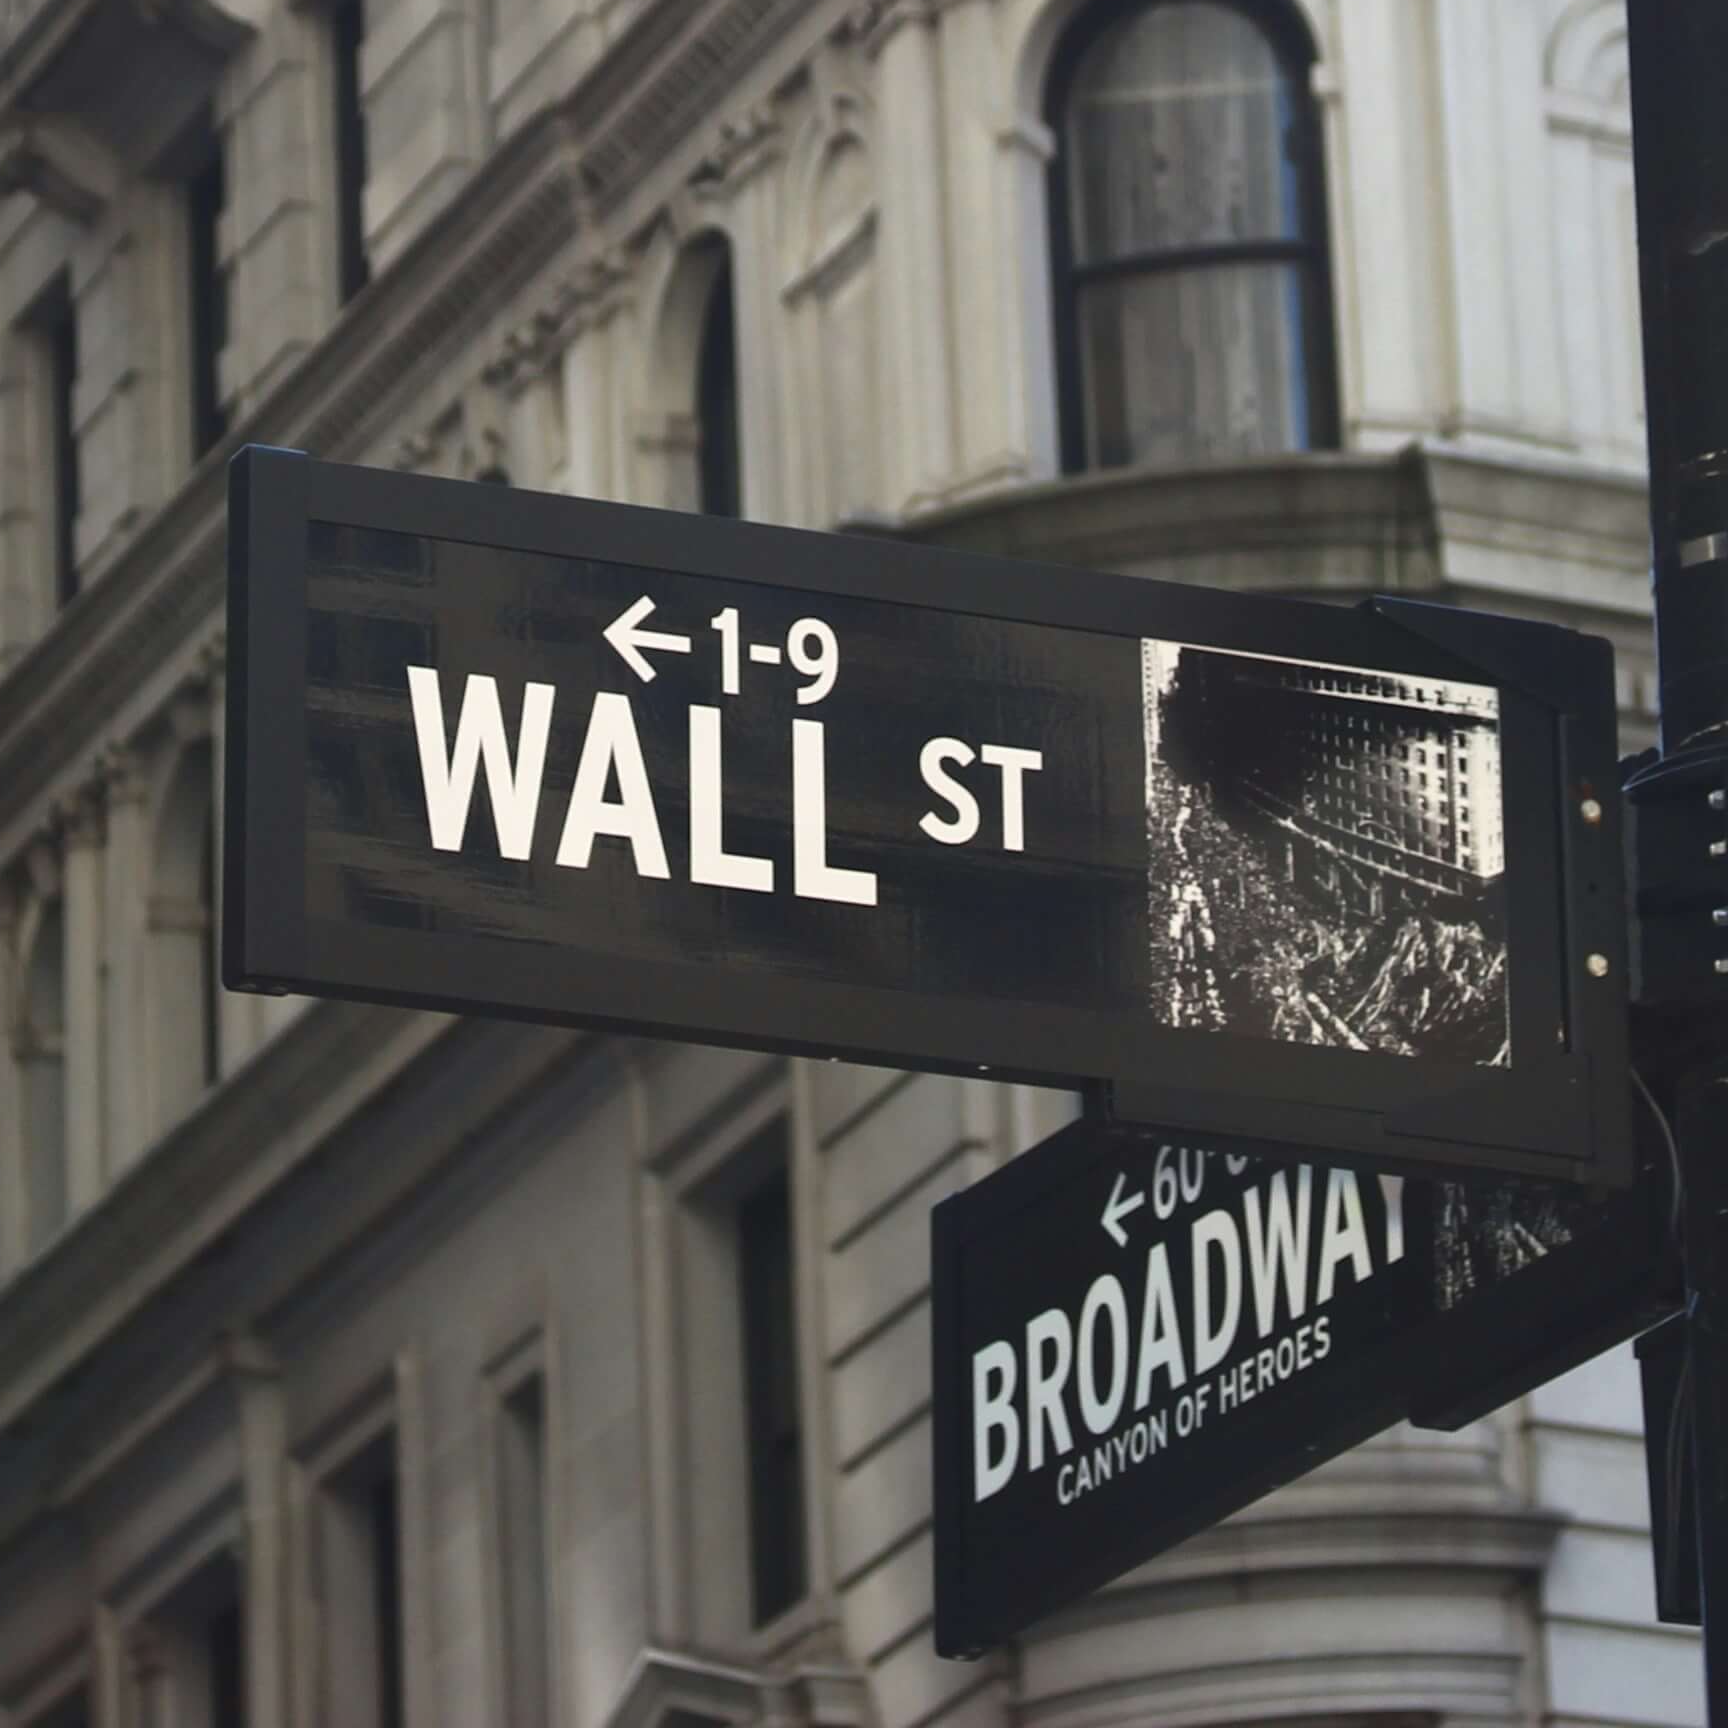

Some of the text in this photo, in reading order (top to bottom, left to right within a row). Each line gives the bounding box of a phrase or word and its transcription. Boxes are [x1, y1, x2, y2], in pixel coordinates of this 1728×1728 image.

[712, 608, 838, 704] 1-9
[407, 666, 1042, 905] WALL ST
[1057, 1316, 1331, 1505] CANYON OF HEROES
